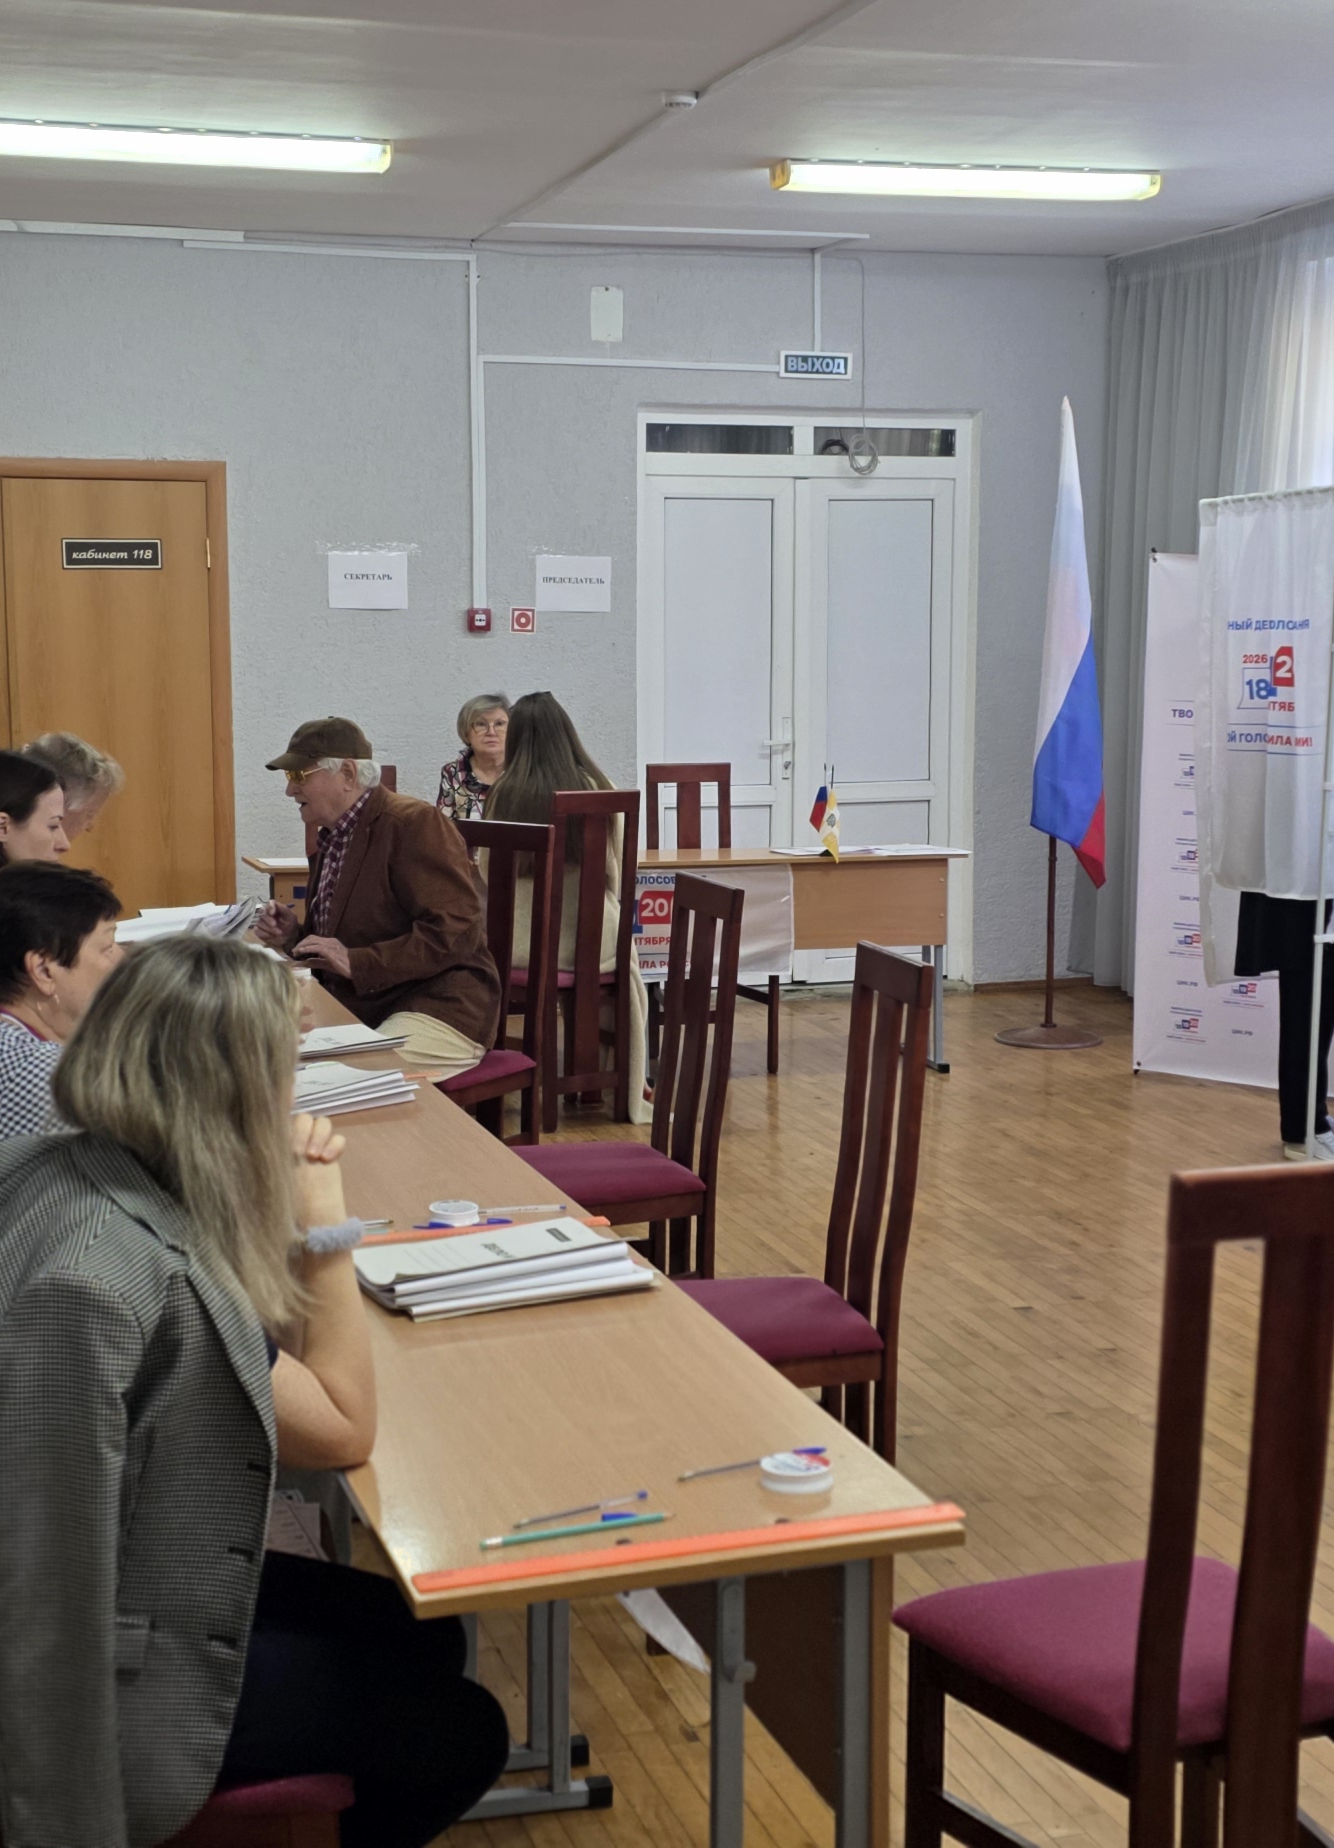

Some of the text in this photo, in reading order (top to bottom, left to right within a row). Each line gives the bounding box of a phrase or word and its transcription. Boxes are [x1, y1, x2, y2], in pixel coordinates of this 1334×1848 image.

[787, 356, 846, 374] ВЫХОД
[72, 549, 153, 559] кабинет 118
[343, 572, 393, 581] СЕКРЕТАРЬ
[542, 576, 605, 585] ПРЕДСЕДАТЕЛЬ
[1227, 618, 1253, 631] НЫЙ
[1242, 654, 1268, 664] 2026
[1245, 655, 1293, 700] 18 2
[1171, 709, 1194, 718] ТВО
[1267, 735, 1292, 746] ИЛА
[641, 898, 669, 917] 20
